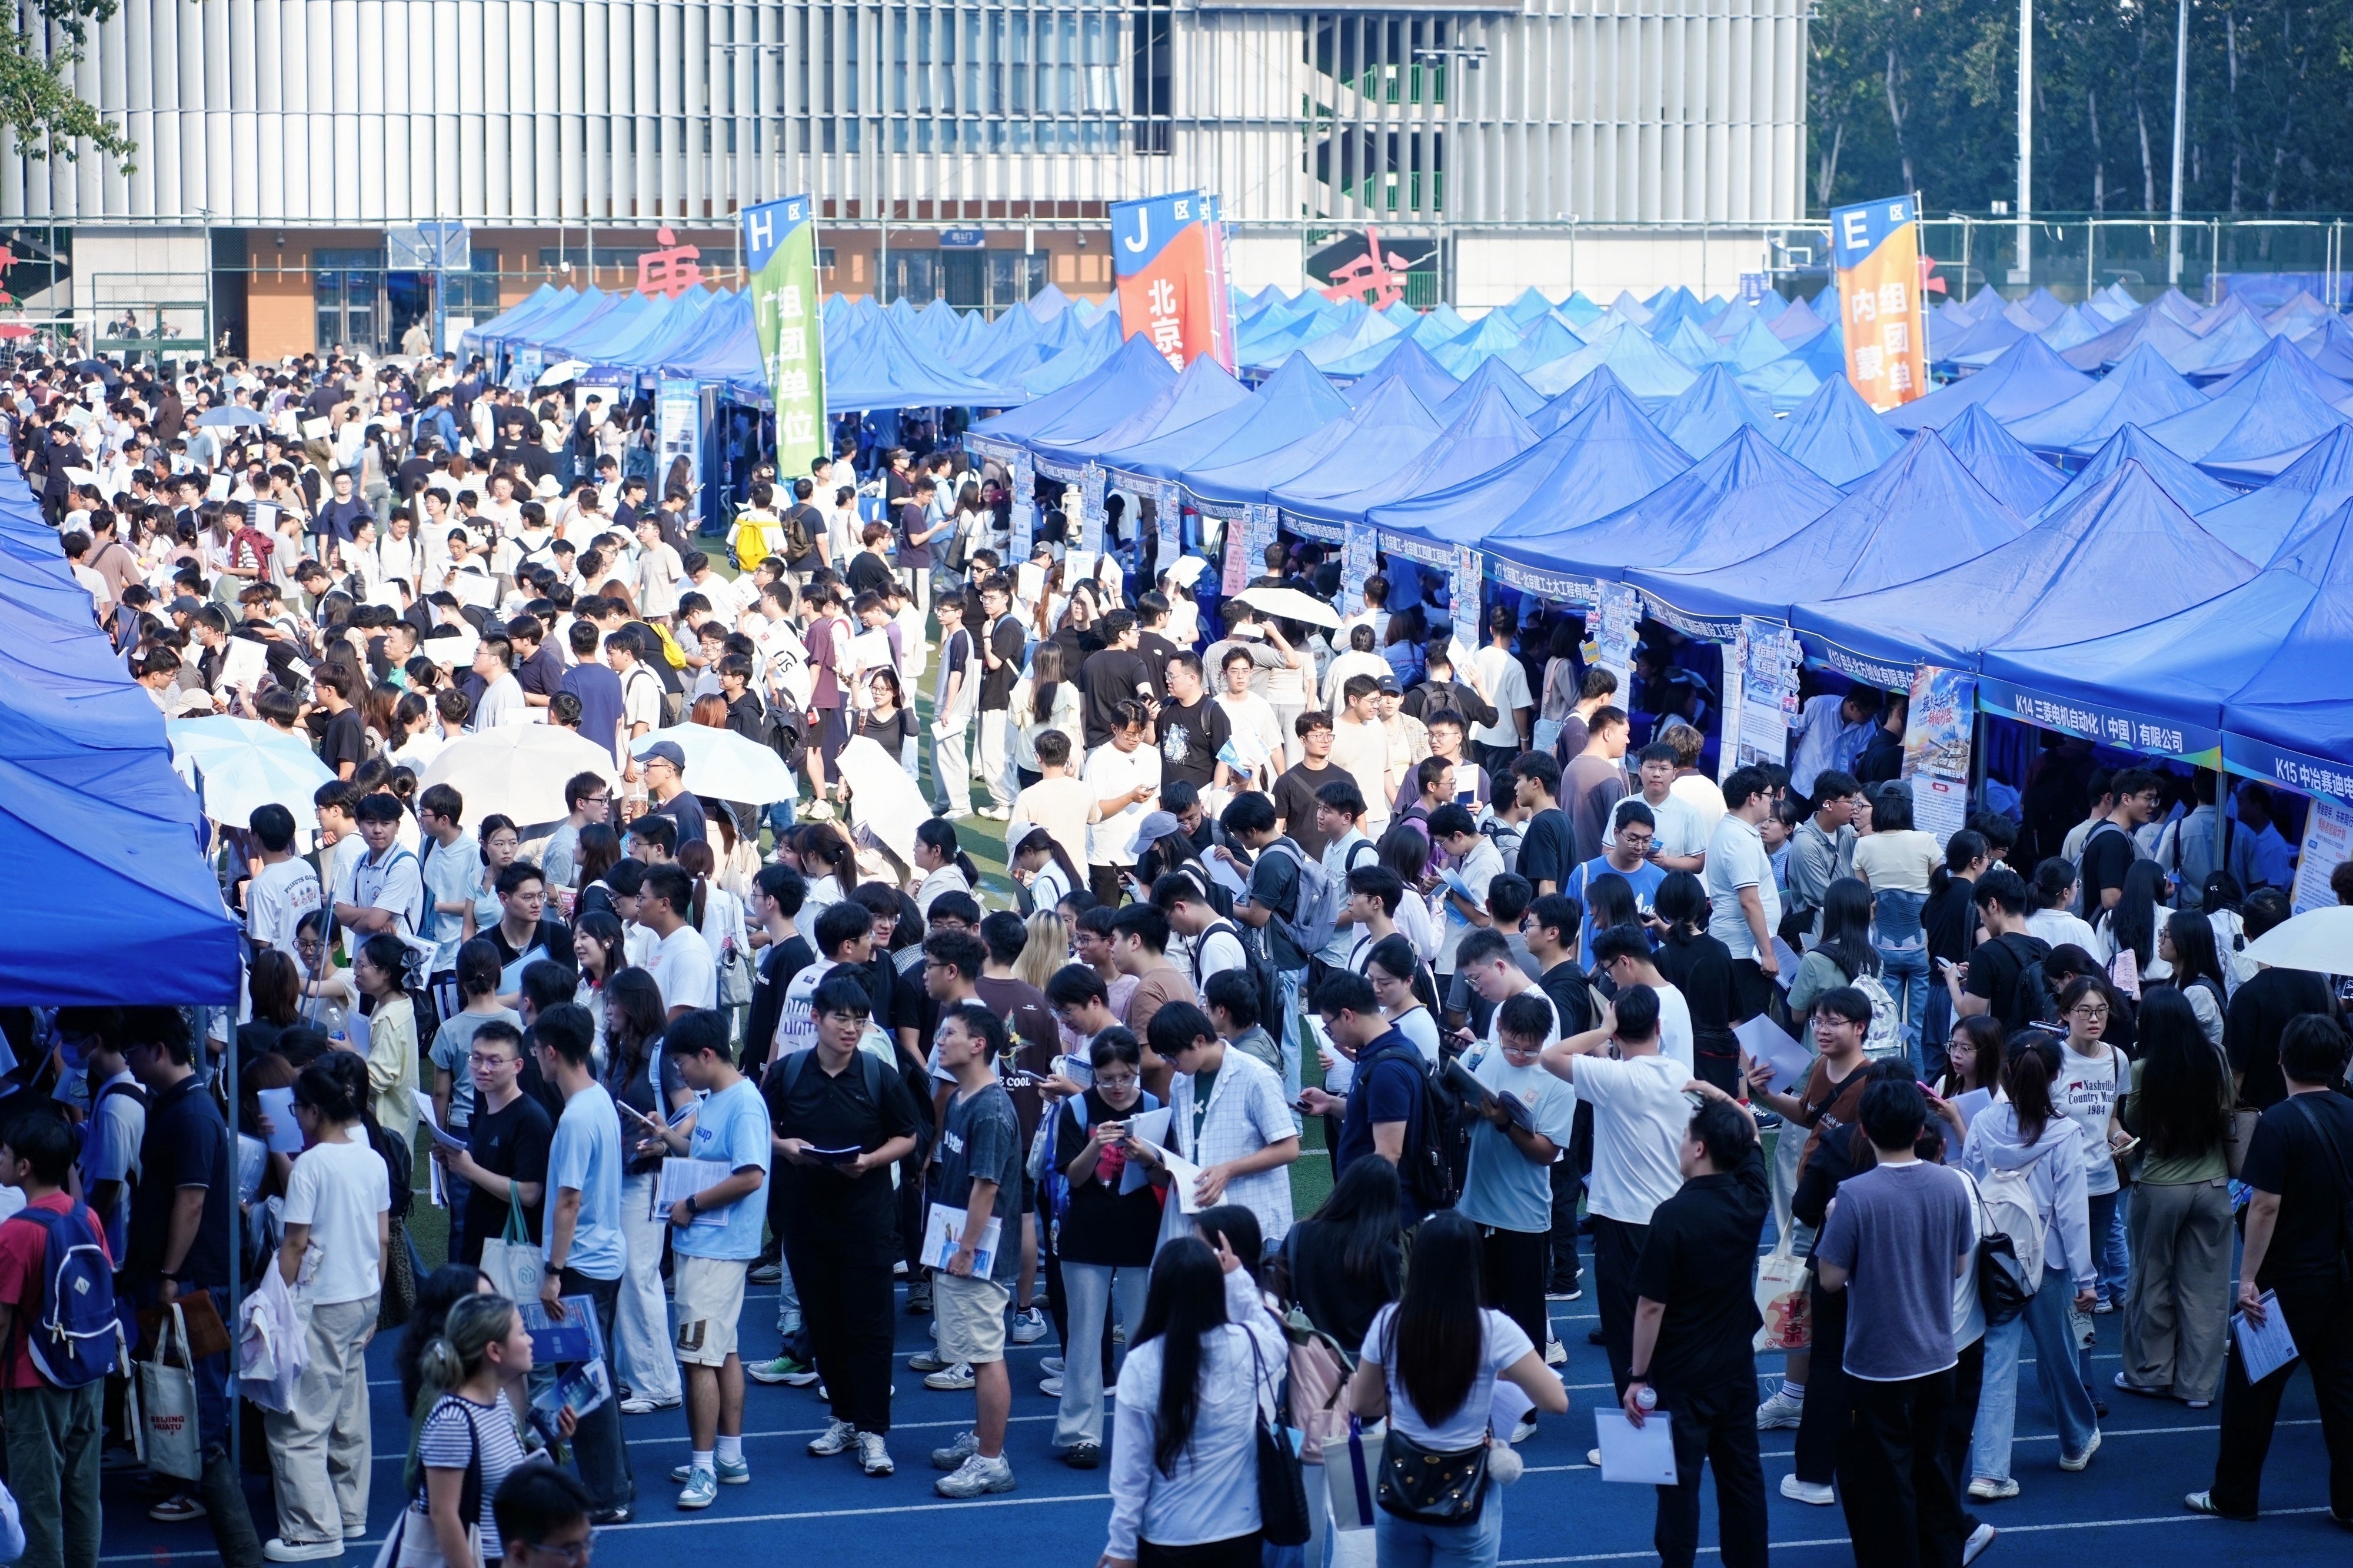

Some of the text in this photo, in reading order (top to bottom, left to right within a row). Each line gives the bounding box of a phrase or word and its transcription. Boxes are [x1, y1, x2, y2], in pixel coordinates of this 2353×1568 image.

[788, 202, 801, 221] 区
[1174, 199, 1190, 221] 区
[1889, 204, 1905, 221] 区
[750, 210, 773, 252] H
[1124, 207, 1149, 253] J
[1843, 211, 1870, 250] E
[1851, 288, 1891, 414] 内蒙
[1879, 282, 1912, 406] 组团单
[777, 284, 816, 446] 组团单位
[1826, 647, 1841, 667] K13
[2015, 694, 2183, 753] K14 三菱电机自动化（中国）有限公司
[2275, 757, 2297, 783] K15
[284, 877, 304, 894] PEANUTS
[1006, 1077, 1031, 1087] COOL
[2084, 1080, 2114, 1092] Nashville
[2068, 1091, 2115, 1105] Country Mus
[2088, 1104, 2105, 1115] 1984
